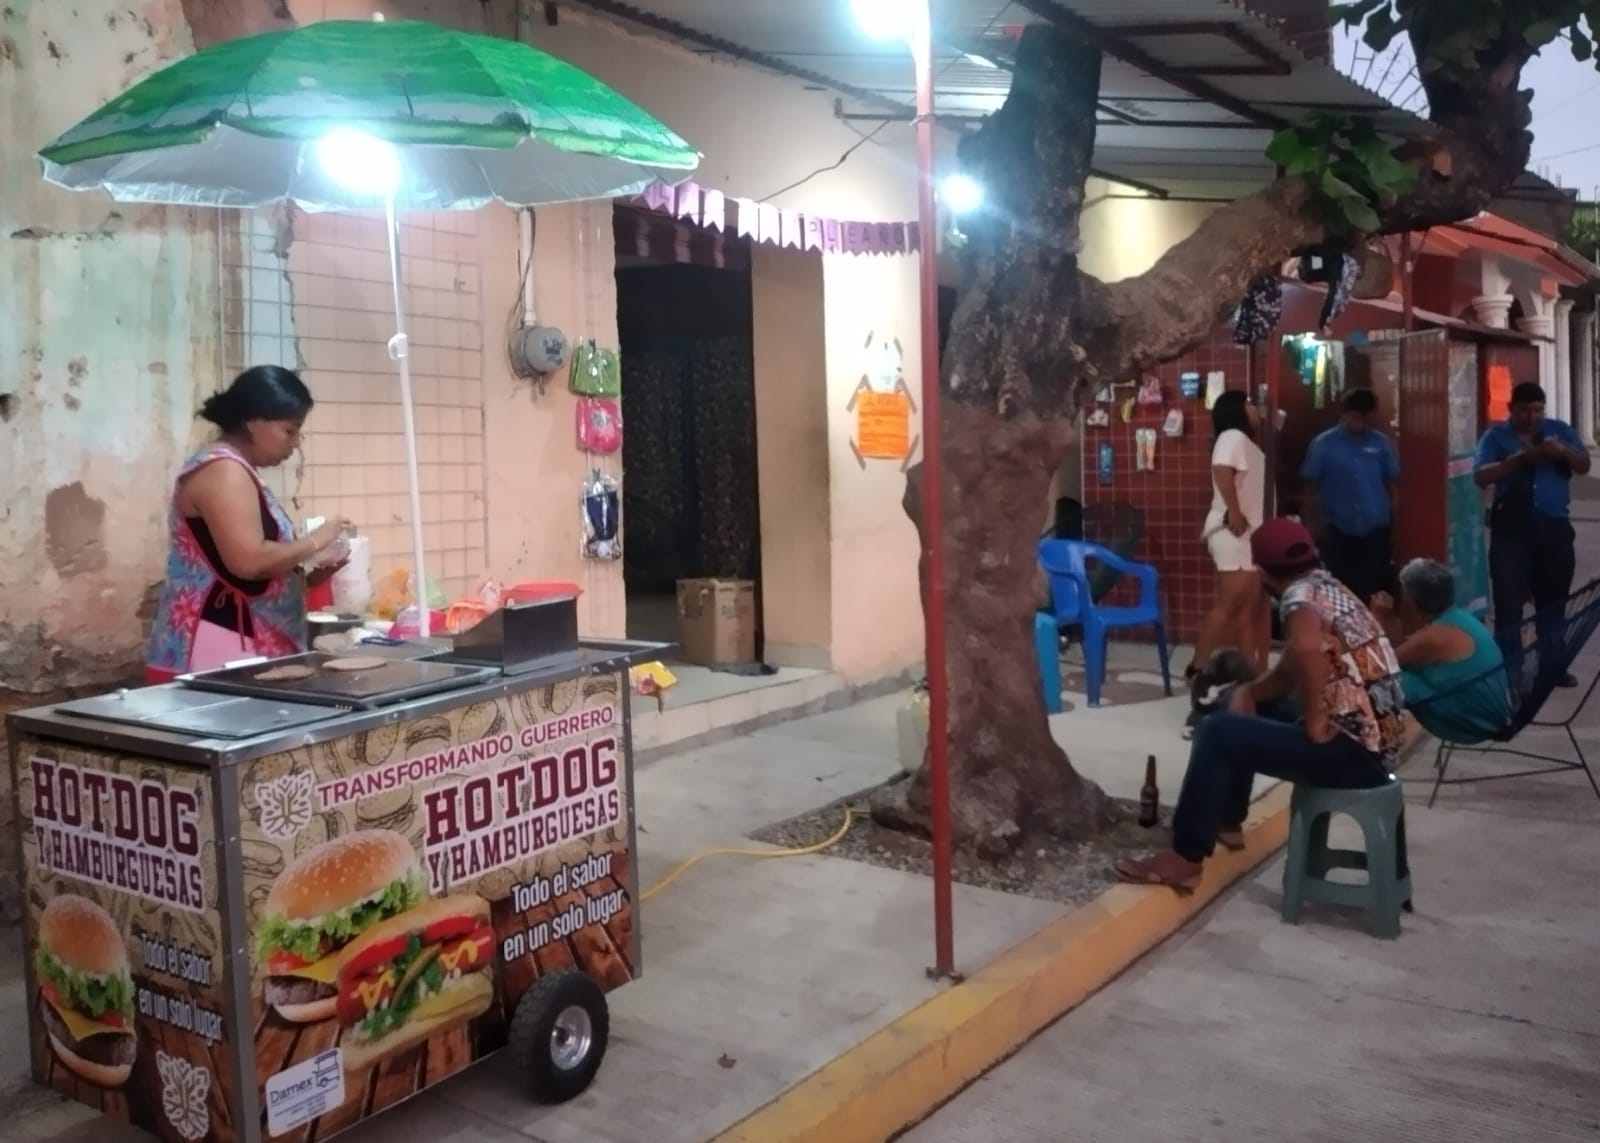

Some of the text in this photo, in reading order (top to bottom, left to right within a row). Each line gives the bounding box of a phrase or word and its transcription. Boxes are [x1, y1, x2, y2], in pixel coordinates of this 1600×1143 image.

[318, 706, 613, 807] TRANSFORMANDO GUERRERO
[36, 825, 204, 909] Y HAMBURGUESAS
[428, 789, 619, 888] Y HAMBURGUESAS
[511, 854, 613, 913] Todo el sabor
[141, 933, 211, 987] Todo el sabor
[503, 889, 624, 962] en un solo lugar
[139, 988, 222, 1047] en un solo lugar
